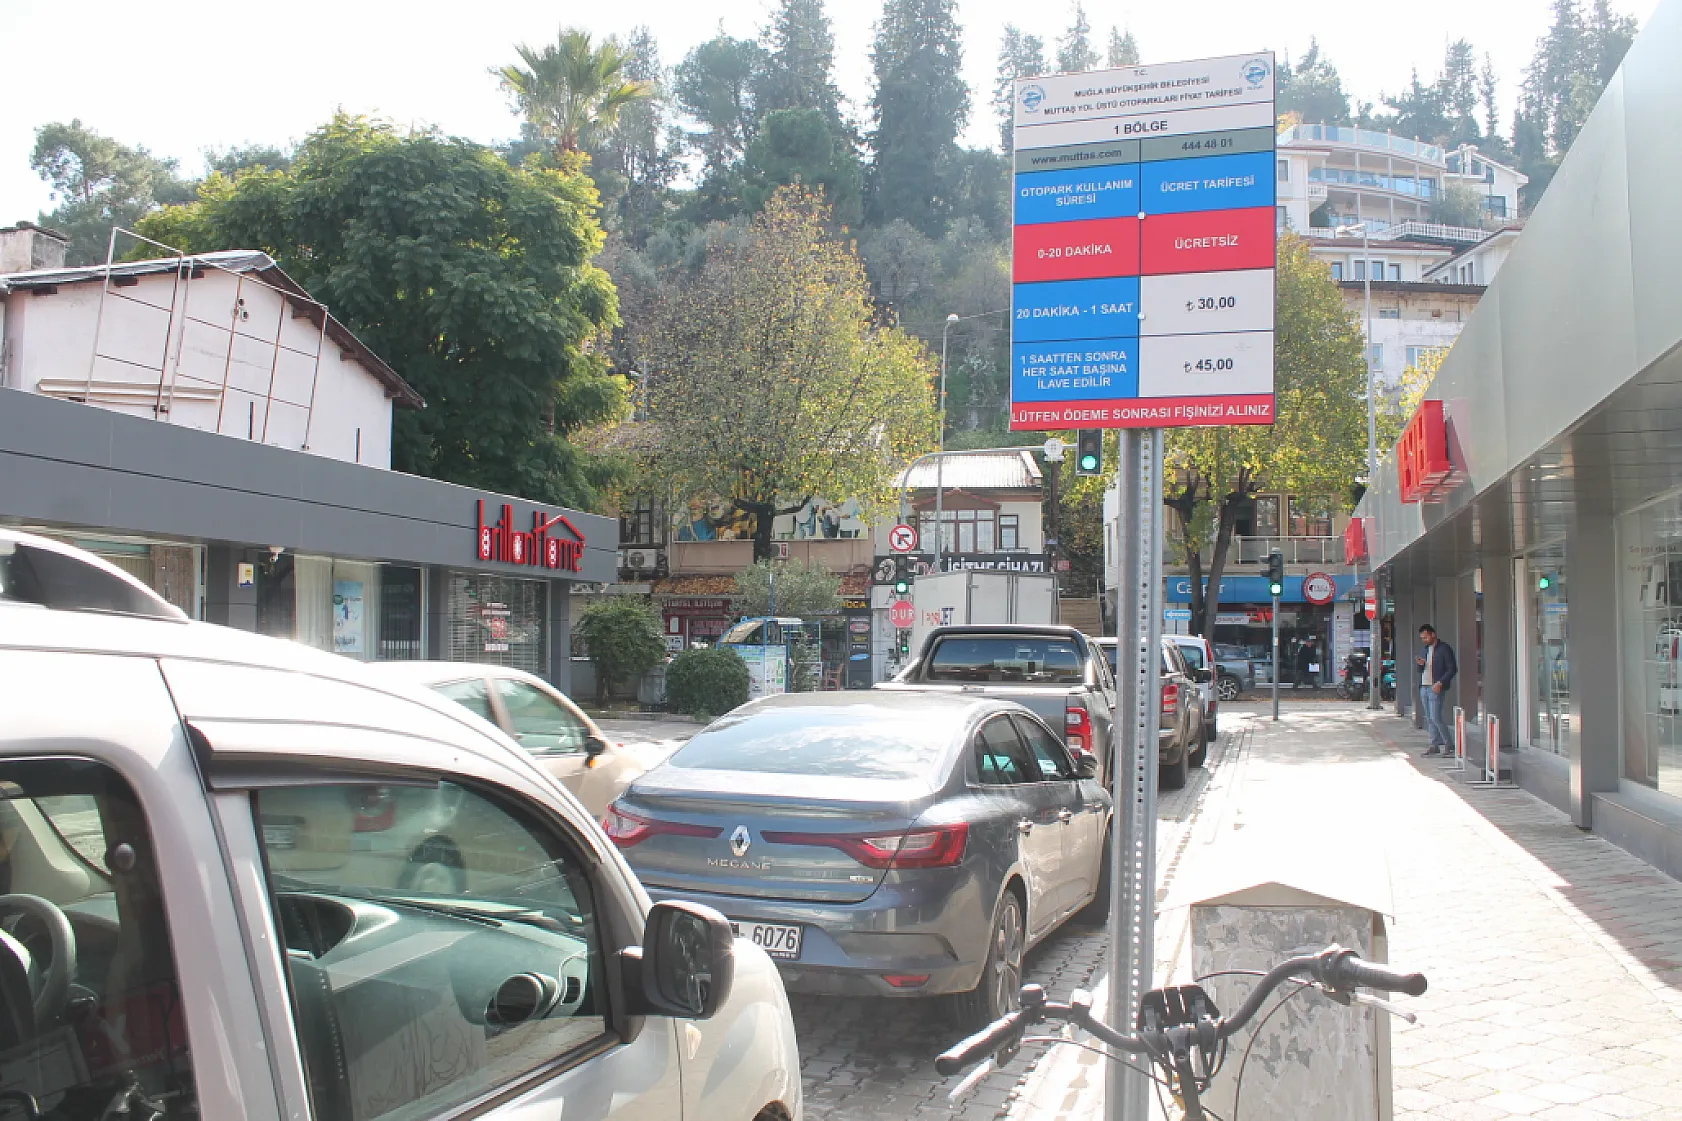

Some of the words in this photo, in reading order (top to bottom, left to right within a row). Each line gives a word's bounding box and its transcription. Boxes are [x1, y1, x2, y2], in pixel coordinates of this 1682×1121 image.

[1074, 87, 1103, 98] MUĞLA
[1105, 81, 1158, 96] BÜYÜKŞEHİR
[1160, 75, 1211, 89] BELEDİYESİ
[1044, 104, 1076, 115] MUTTAŞ
[1078, 103, 1094, 112] YOL
[1096, 99, 1118, 110] ÜSTÜ
[1119, 94, 1178, 107] OTOPARKLARI
[1179, 91, 1202, 102] FİYAT
[1204, 86, 1243, 98] TARİFESİ
[1114, 125, 1120, 135] 1
[1124, 121, 1168, 134] BÖLGE
[1181, 141, 1201, 151] 444
[1204, 139, 1217, 149] 48
[1220, 138, 1233, 148] 01
[1031, 149, 1122, 165] www.muttas.com
[1021, 184, 1073, 197] OTOPARK
[1075, 179, 1133, 193] KULLANIM
[1160, 179, 1199, 193] ÜCRET
[1203, 174, 1255, 189] TARİFESİ
[1055, 192, 1096, 207] SÜRESİ
[1174, 234, 1239, 249] ÜCRETSİZ
[1037, 248, 1062, 259] 0-20
[1065, 243, 1112, 257] DAKİKA
[1016, 308, 1030, 319] 20
[1033, 303, 1080, 319] DAKİKA
[1090, 305, 1096, 315] 1
[1100, 302, 1133, 314] SAAT
[1198, 297, 1235, 311] 30,00
[1020, 355, 1026, 364] 1
[1029, 352, 1082, 364] SAATTEN
[1084, 350, 1127, 362] SONRA
[1022, 366, 1046, 377] HER
[1049, 365, 1080, 376] SAAT
[1083, 363, 1127, 377] BAŞINA
[1195, 358, 1233, 374] 45,00
[1037, 376, 1070, 390] İLAVE
[1073, 374, 1111, 388] EDİLİR
[1011, 410, 1060, 423] LÜTFEN
[1063, 407, 1109, 421] ÖDEME
[1112, 406, 1171, 420] SONRASI
[1174, 402, 1224, 420] FİŞİNİZİ
[1226, 403, 1270, 418] ALINIZ
[891, 608, 915, 620] DUR
[707, 857, 772, 870] MEGANE
[753, 924, 797, 950] 6076
